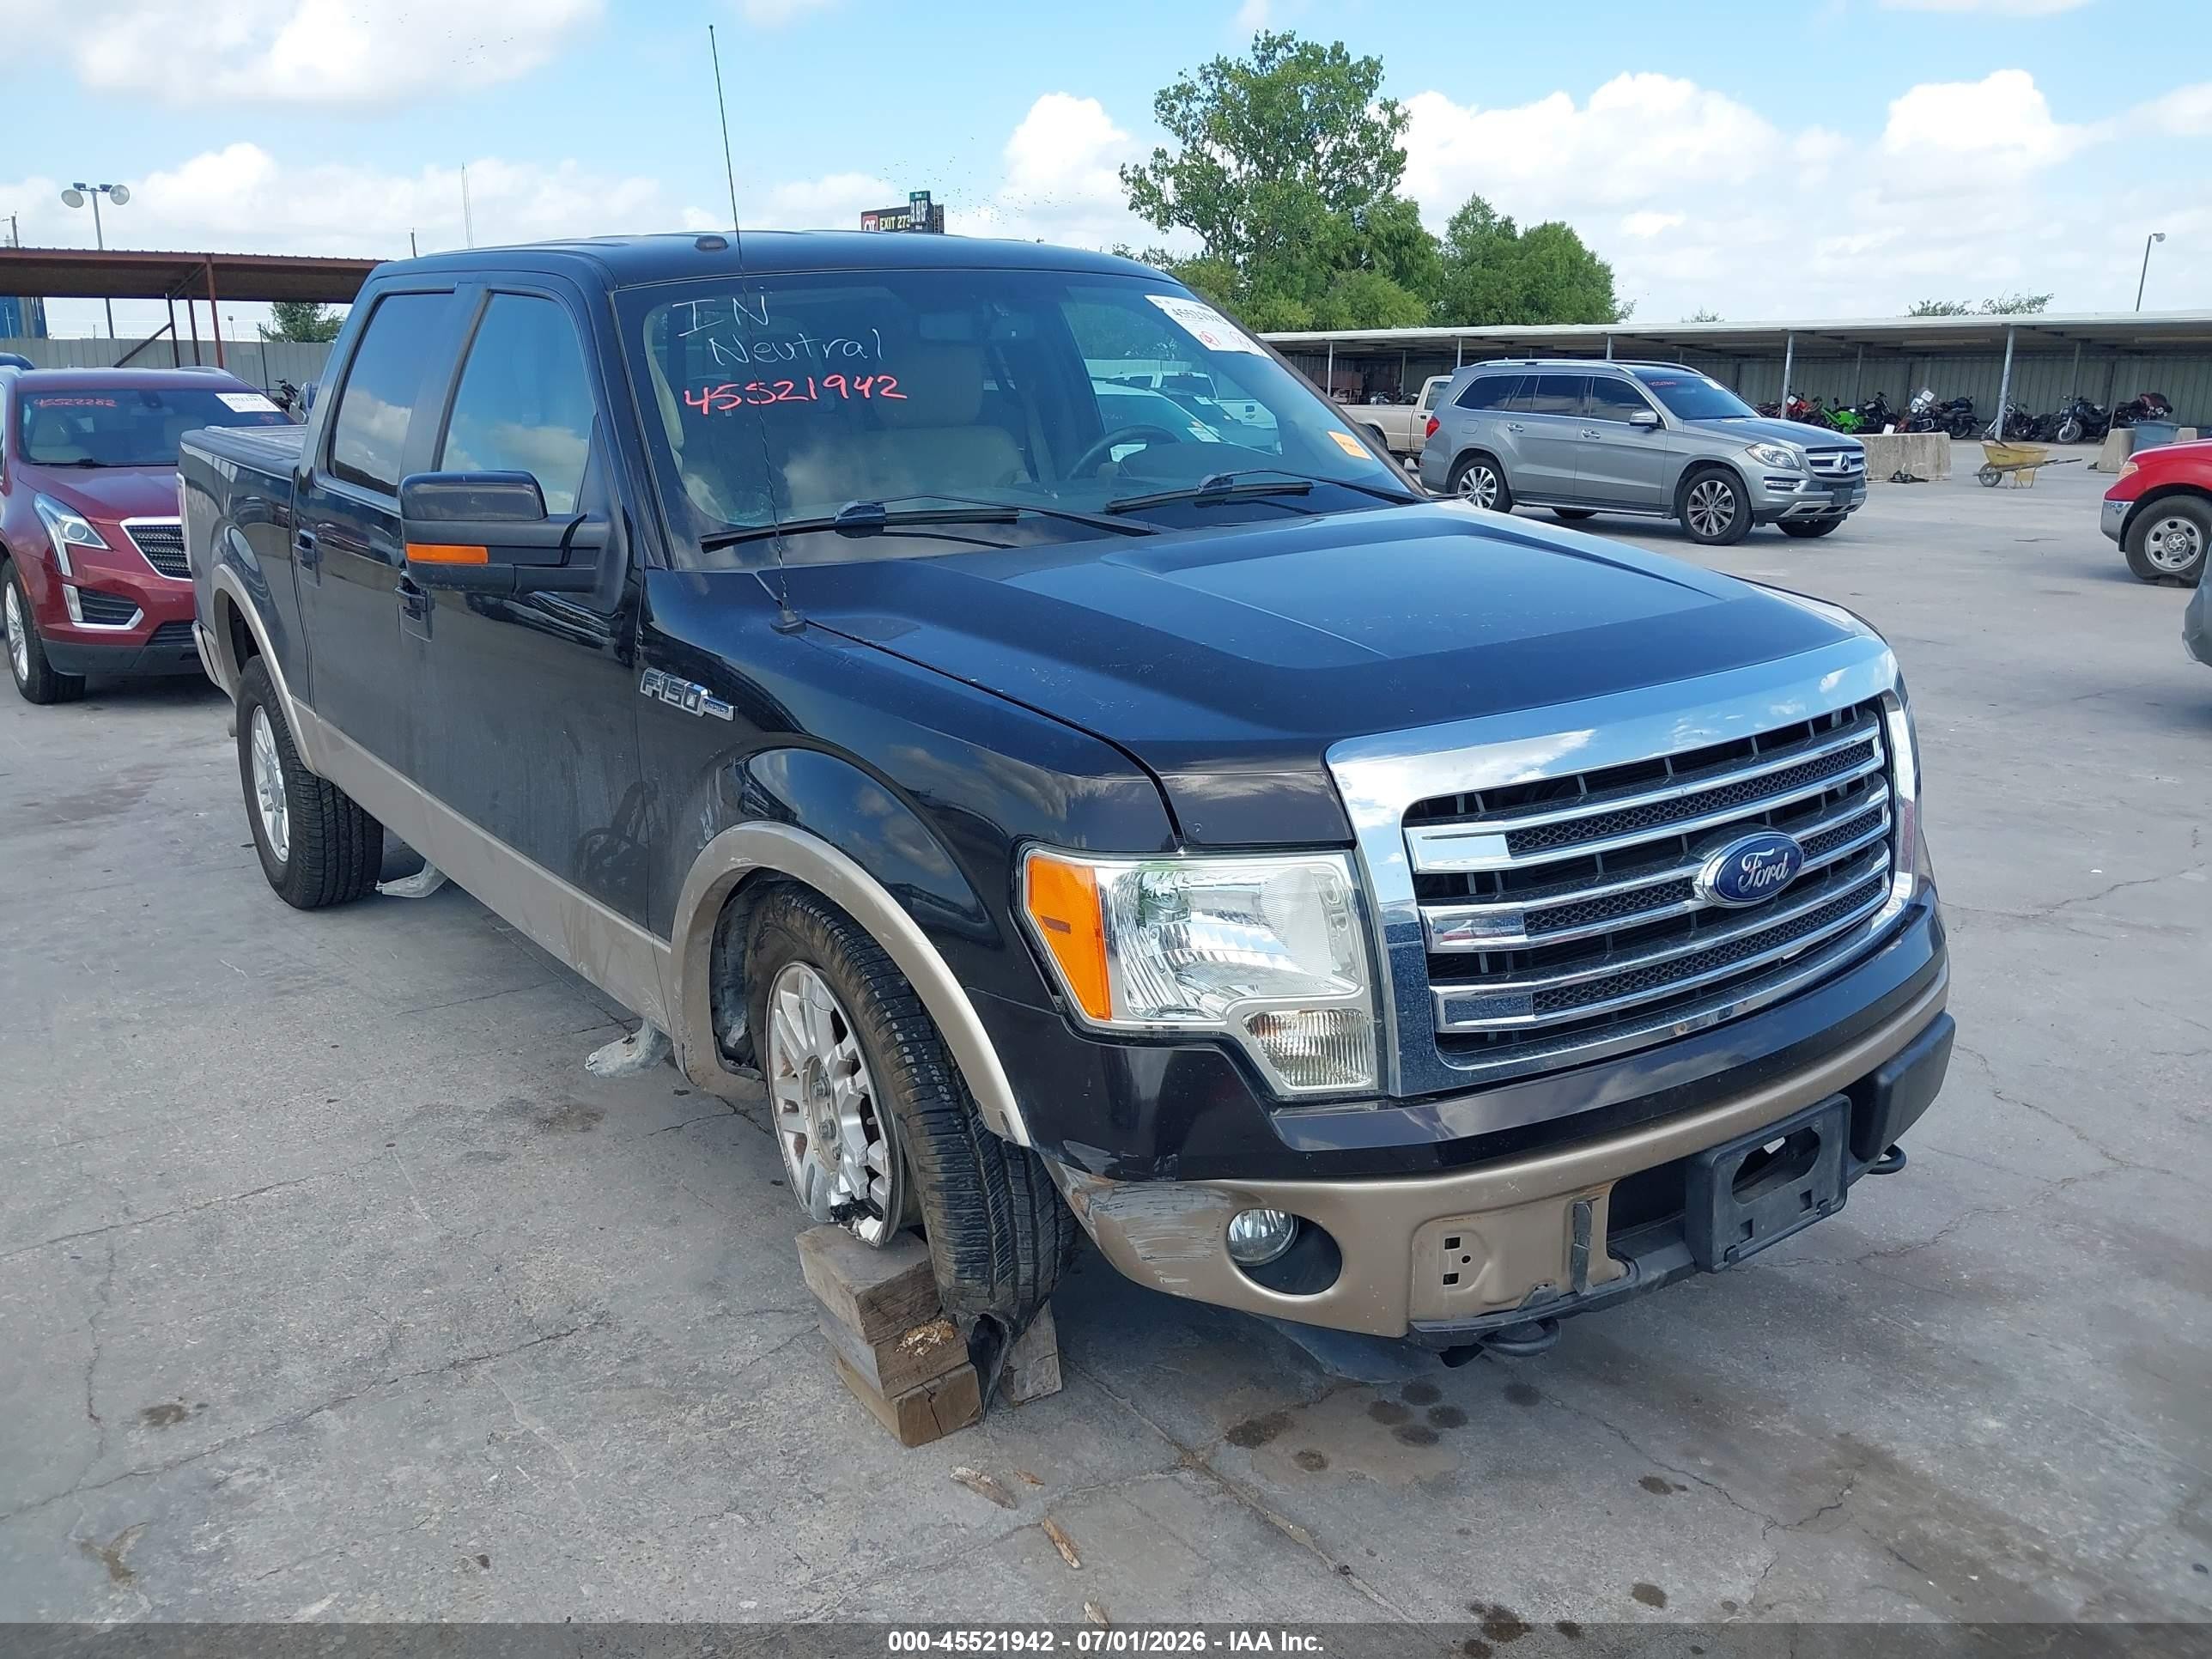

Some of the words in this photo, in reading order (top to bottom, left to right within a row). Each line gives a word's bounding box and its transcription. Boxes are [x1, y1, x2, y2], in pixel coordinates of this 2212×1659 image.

[879, 216, 896, 231] EXIT
[672, 295, 769, 337] IN
[708, 328, 883, 366] Neutral
[684, 374, 908, 416] 45521942
[1737, 848, 1790, 894] Ford
